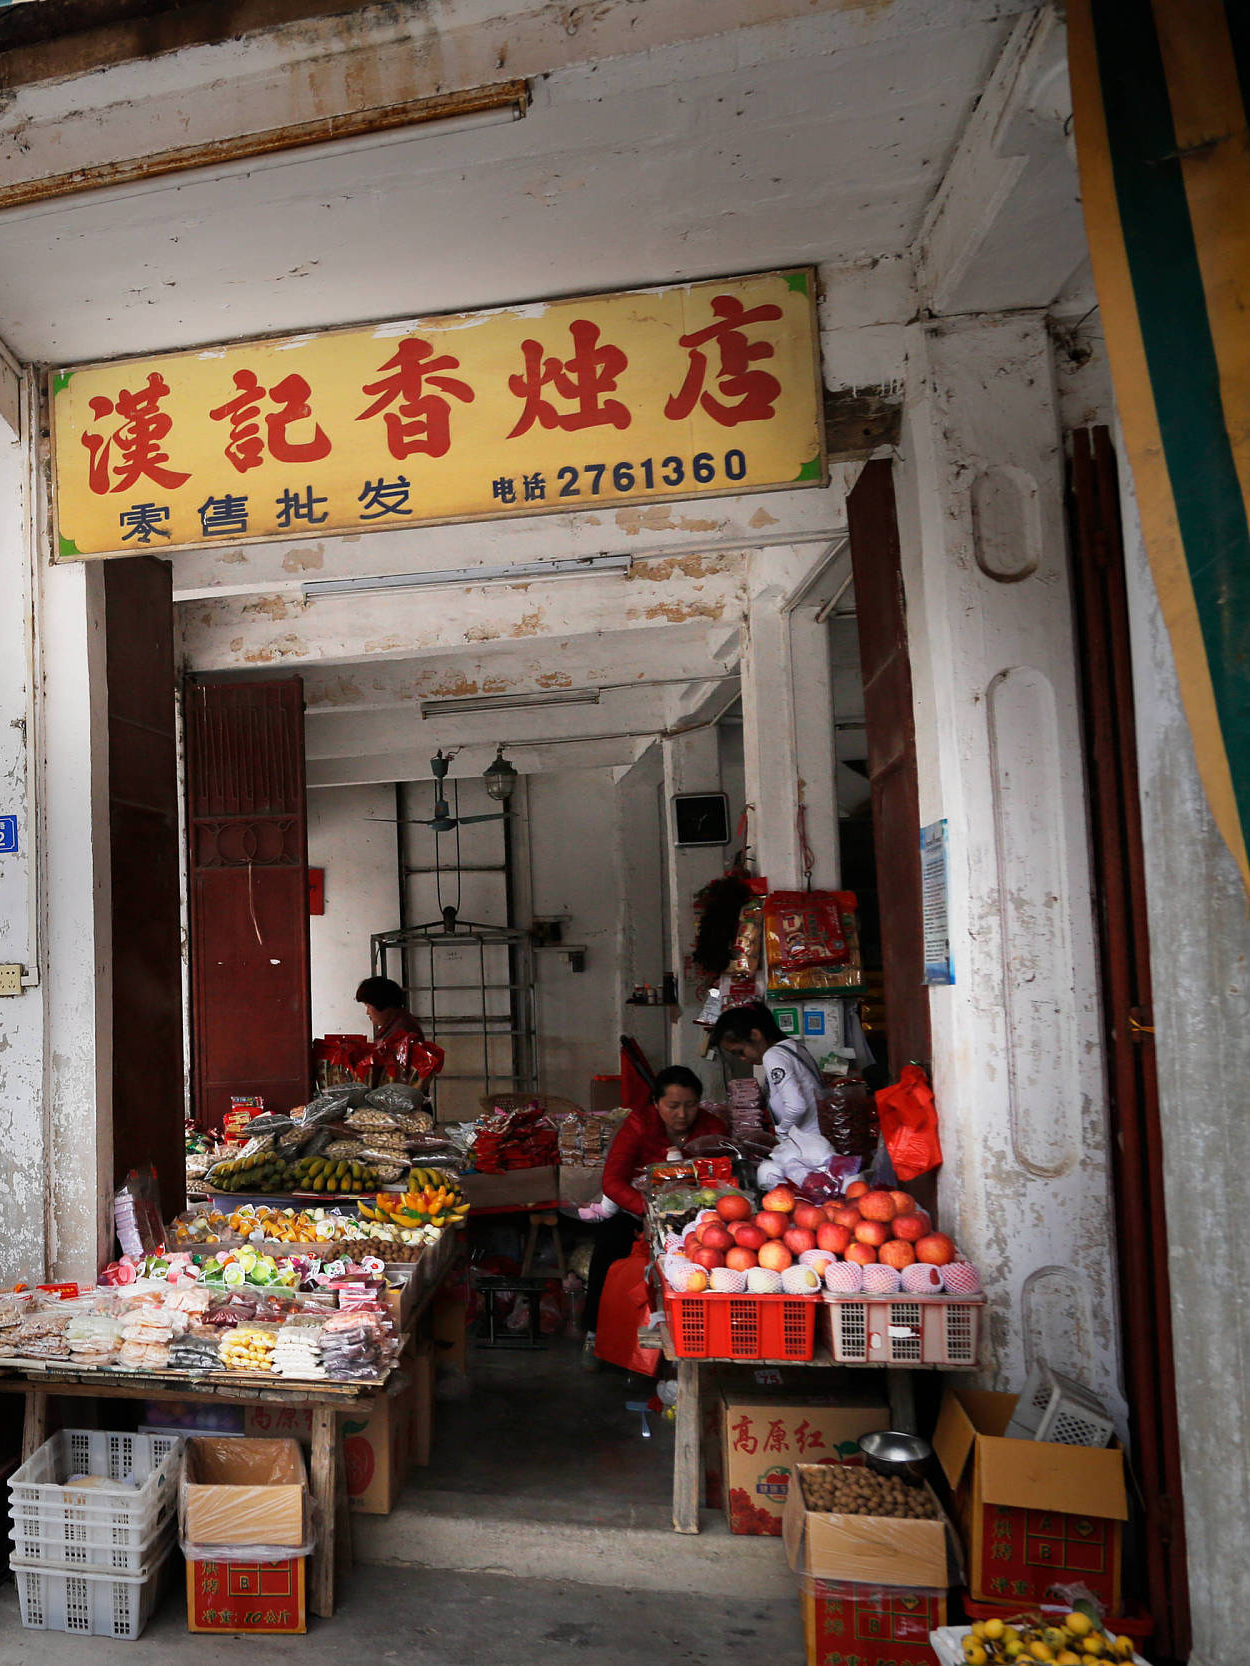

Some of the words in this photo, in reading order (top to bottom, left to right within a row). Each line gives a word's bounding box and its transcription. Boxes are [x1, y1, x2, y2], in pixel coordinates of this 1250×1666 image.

[81, 294, 783, 495] 漢記香烛店
[119, 476, 413, 544] 零售批发
[732, 1415, 825, 1455] 高原红
[1039, 1543, 1051, 1560] B
[240, 1575, 249, 1590] B
